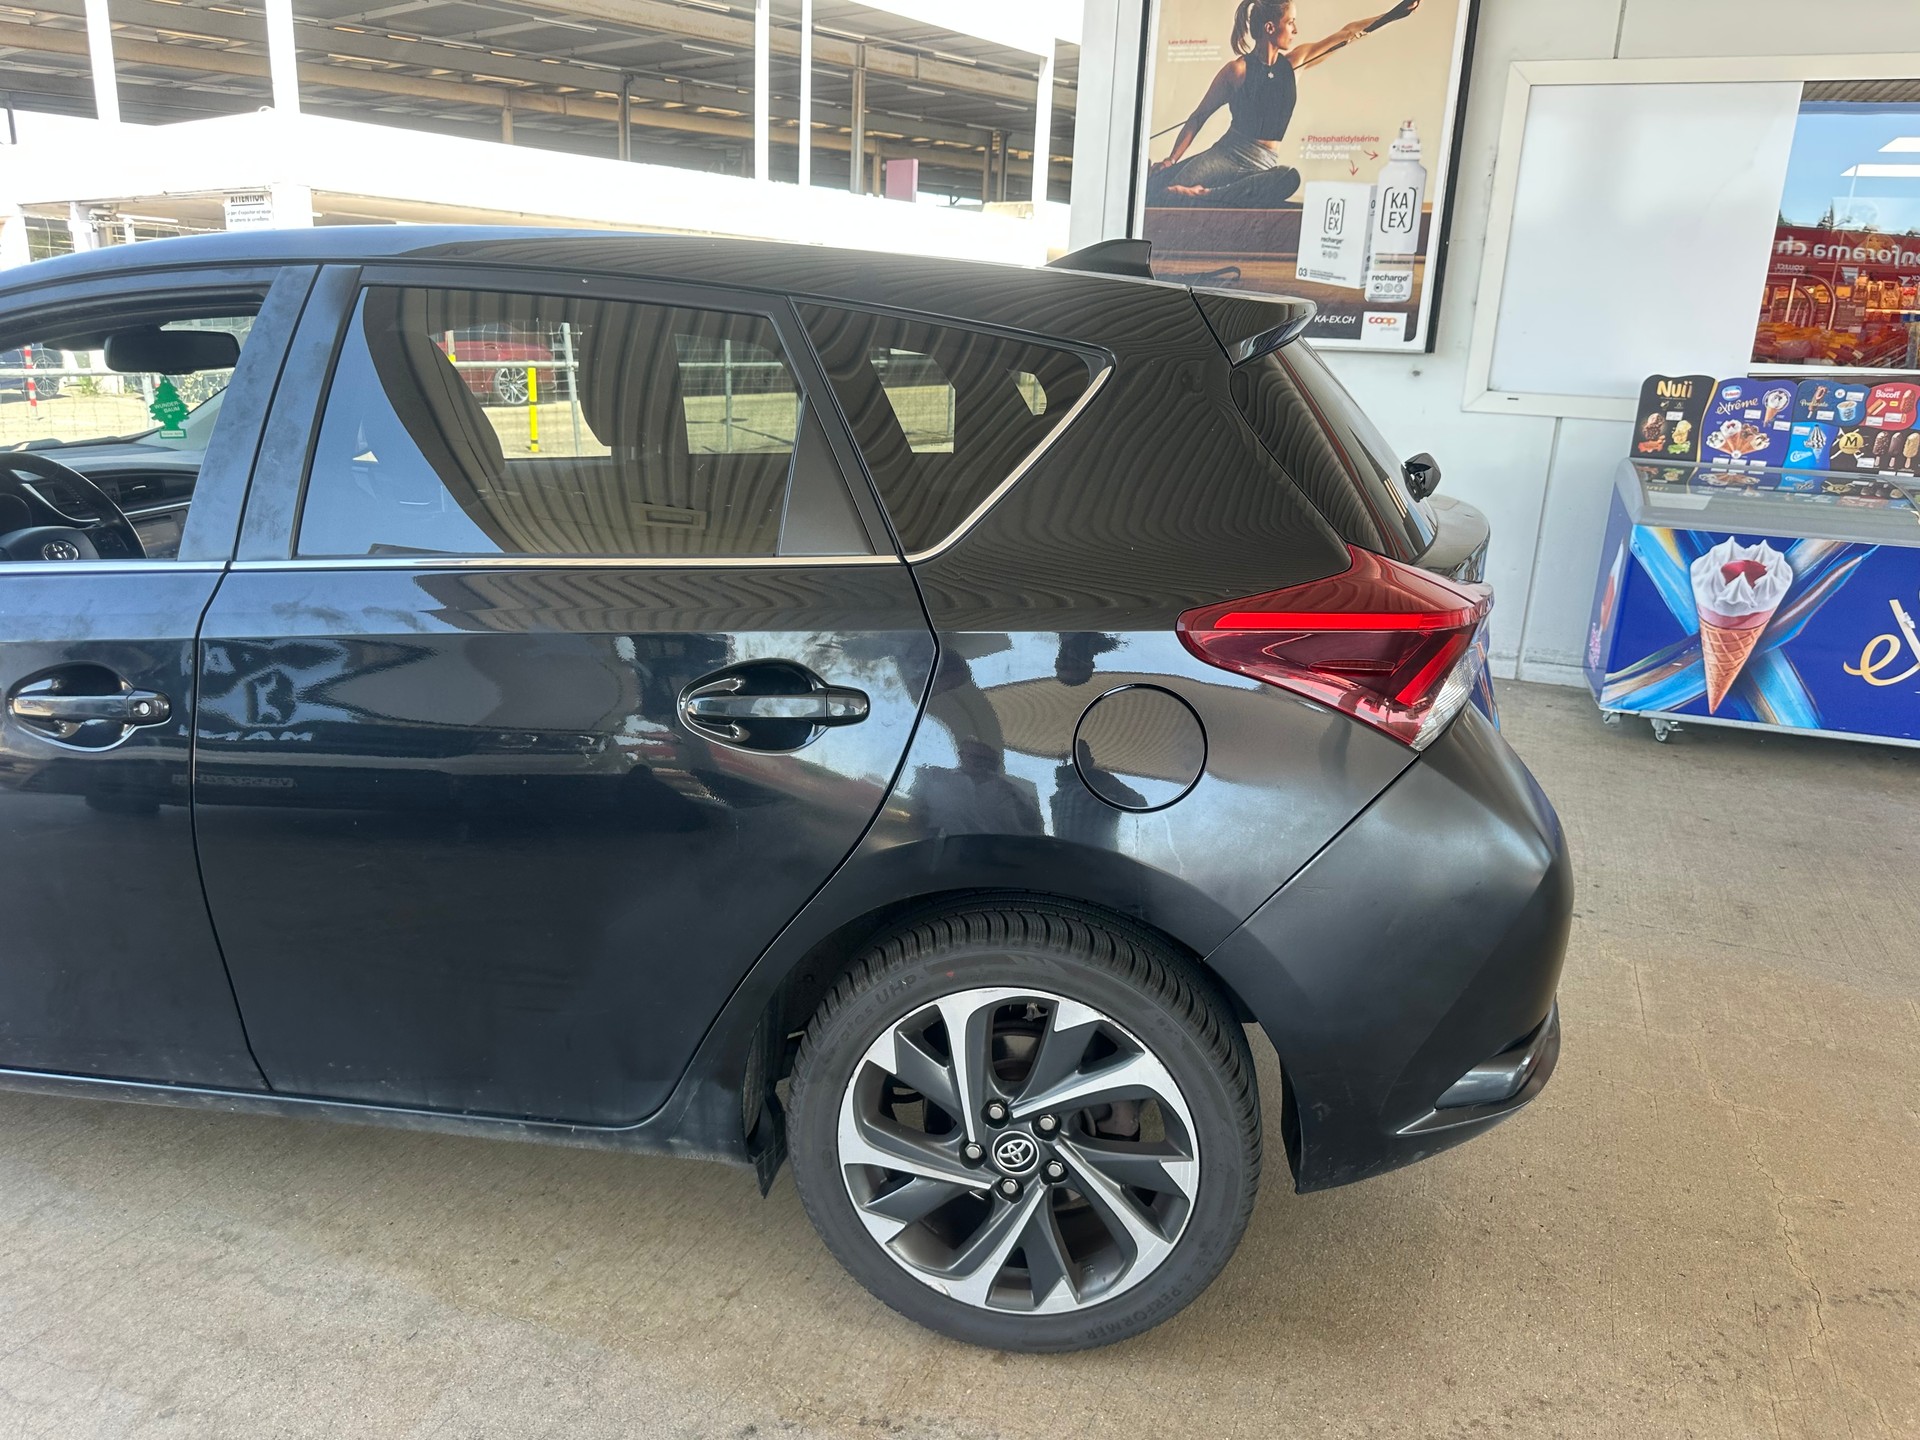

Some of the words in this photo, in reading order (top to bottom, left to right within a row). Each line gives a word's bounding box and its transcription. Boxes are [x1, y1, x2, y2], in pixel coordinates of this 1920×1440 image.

[1307, 135, 1379, 143] Phosphatidylsérine
[230, 195, 265, 203] ATTENTION
[1390, 192, 1408, 209] KA
[1329, 202, 1340, 215] KA
[1328, 217, 1340, 231] EX
[1388, 211, 1408, 228] EX
[1321, 236, 1342, 244] recharge
[1298, 267, 1307, 277] 03
[1372, 273, 1407, 283] recharge
[1314, 314, 1356, 324] KA-EX.CH
[1369, 316, 1397, 326] coop
[1657, 380, 1692, 398] Nuii
[1875, 389, 1901, 398] Biscoff
